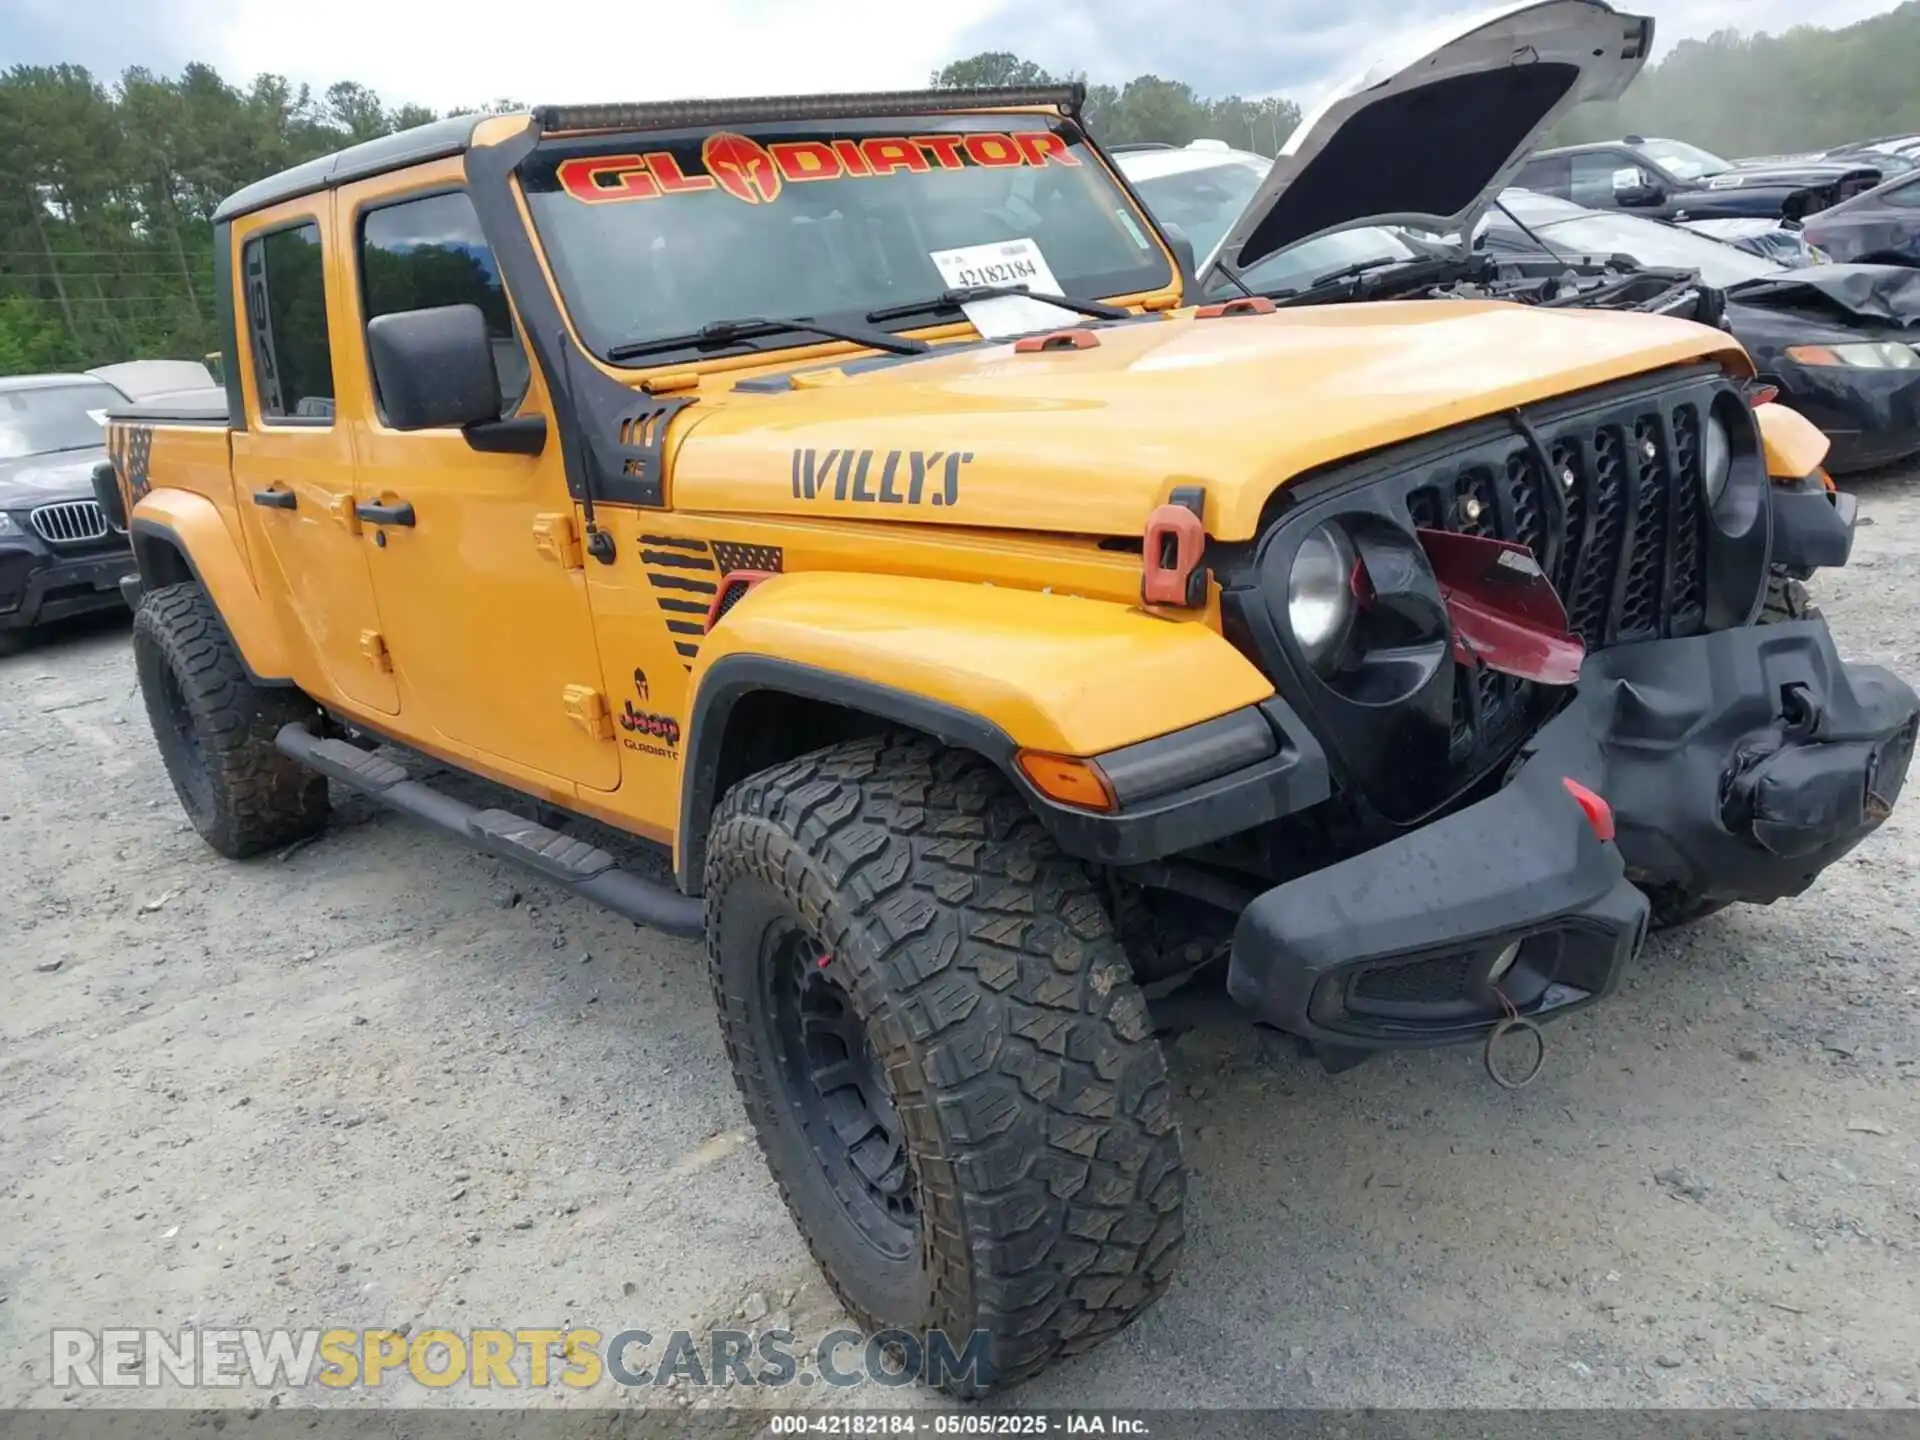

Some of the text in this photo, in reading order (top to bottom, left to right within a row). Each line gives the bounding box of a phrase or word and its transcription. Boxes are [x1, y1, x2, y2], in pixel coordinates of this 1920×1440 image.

[958, 258, 1037, 287] 42182184
[792, 448, 974, 506] WILLYS
[620, 698, 680, 747] Jeep
[623, 738, 680, 761] GLADIATO
